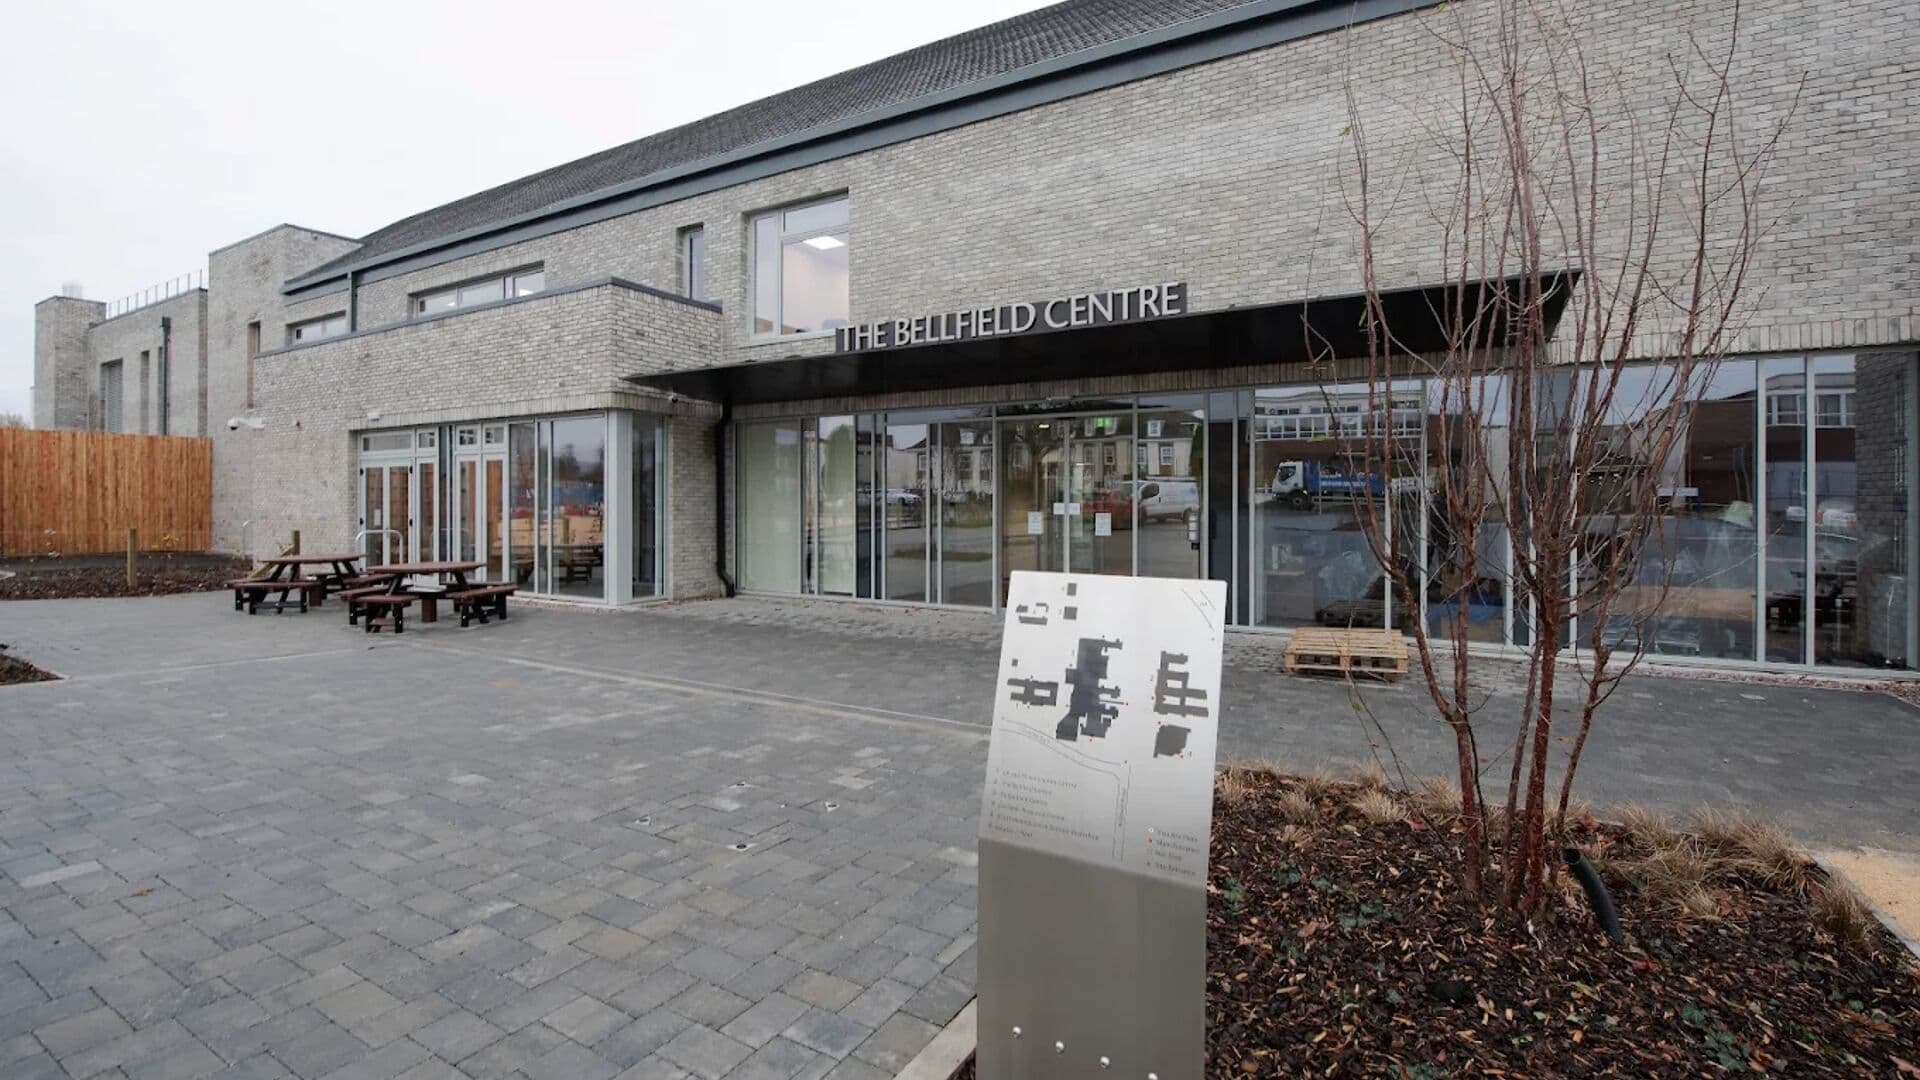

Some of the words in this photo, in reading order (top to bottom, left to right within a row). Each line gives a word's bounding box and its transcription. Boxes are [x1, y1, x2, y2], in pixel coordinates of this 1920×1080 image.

[838, 322, 887, 351] THE
[894, 302, 1037, 346] BELLFIELD
[1044, 282, 1181, 328] CENTRE
